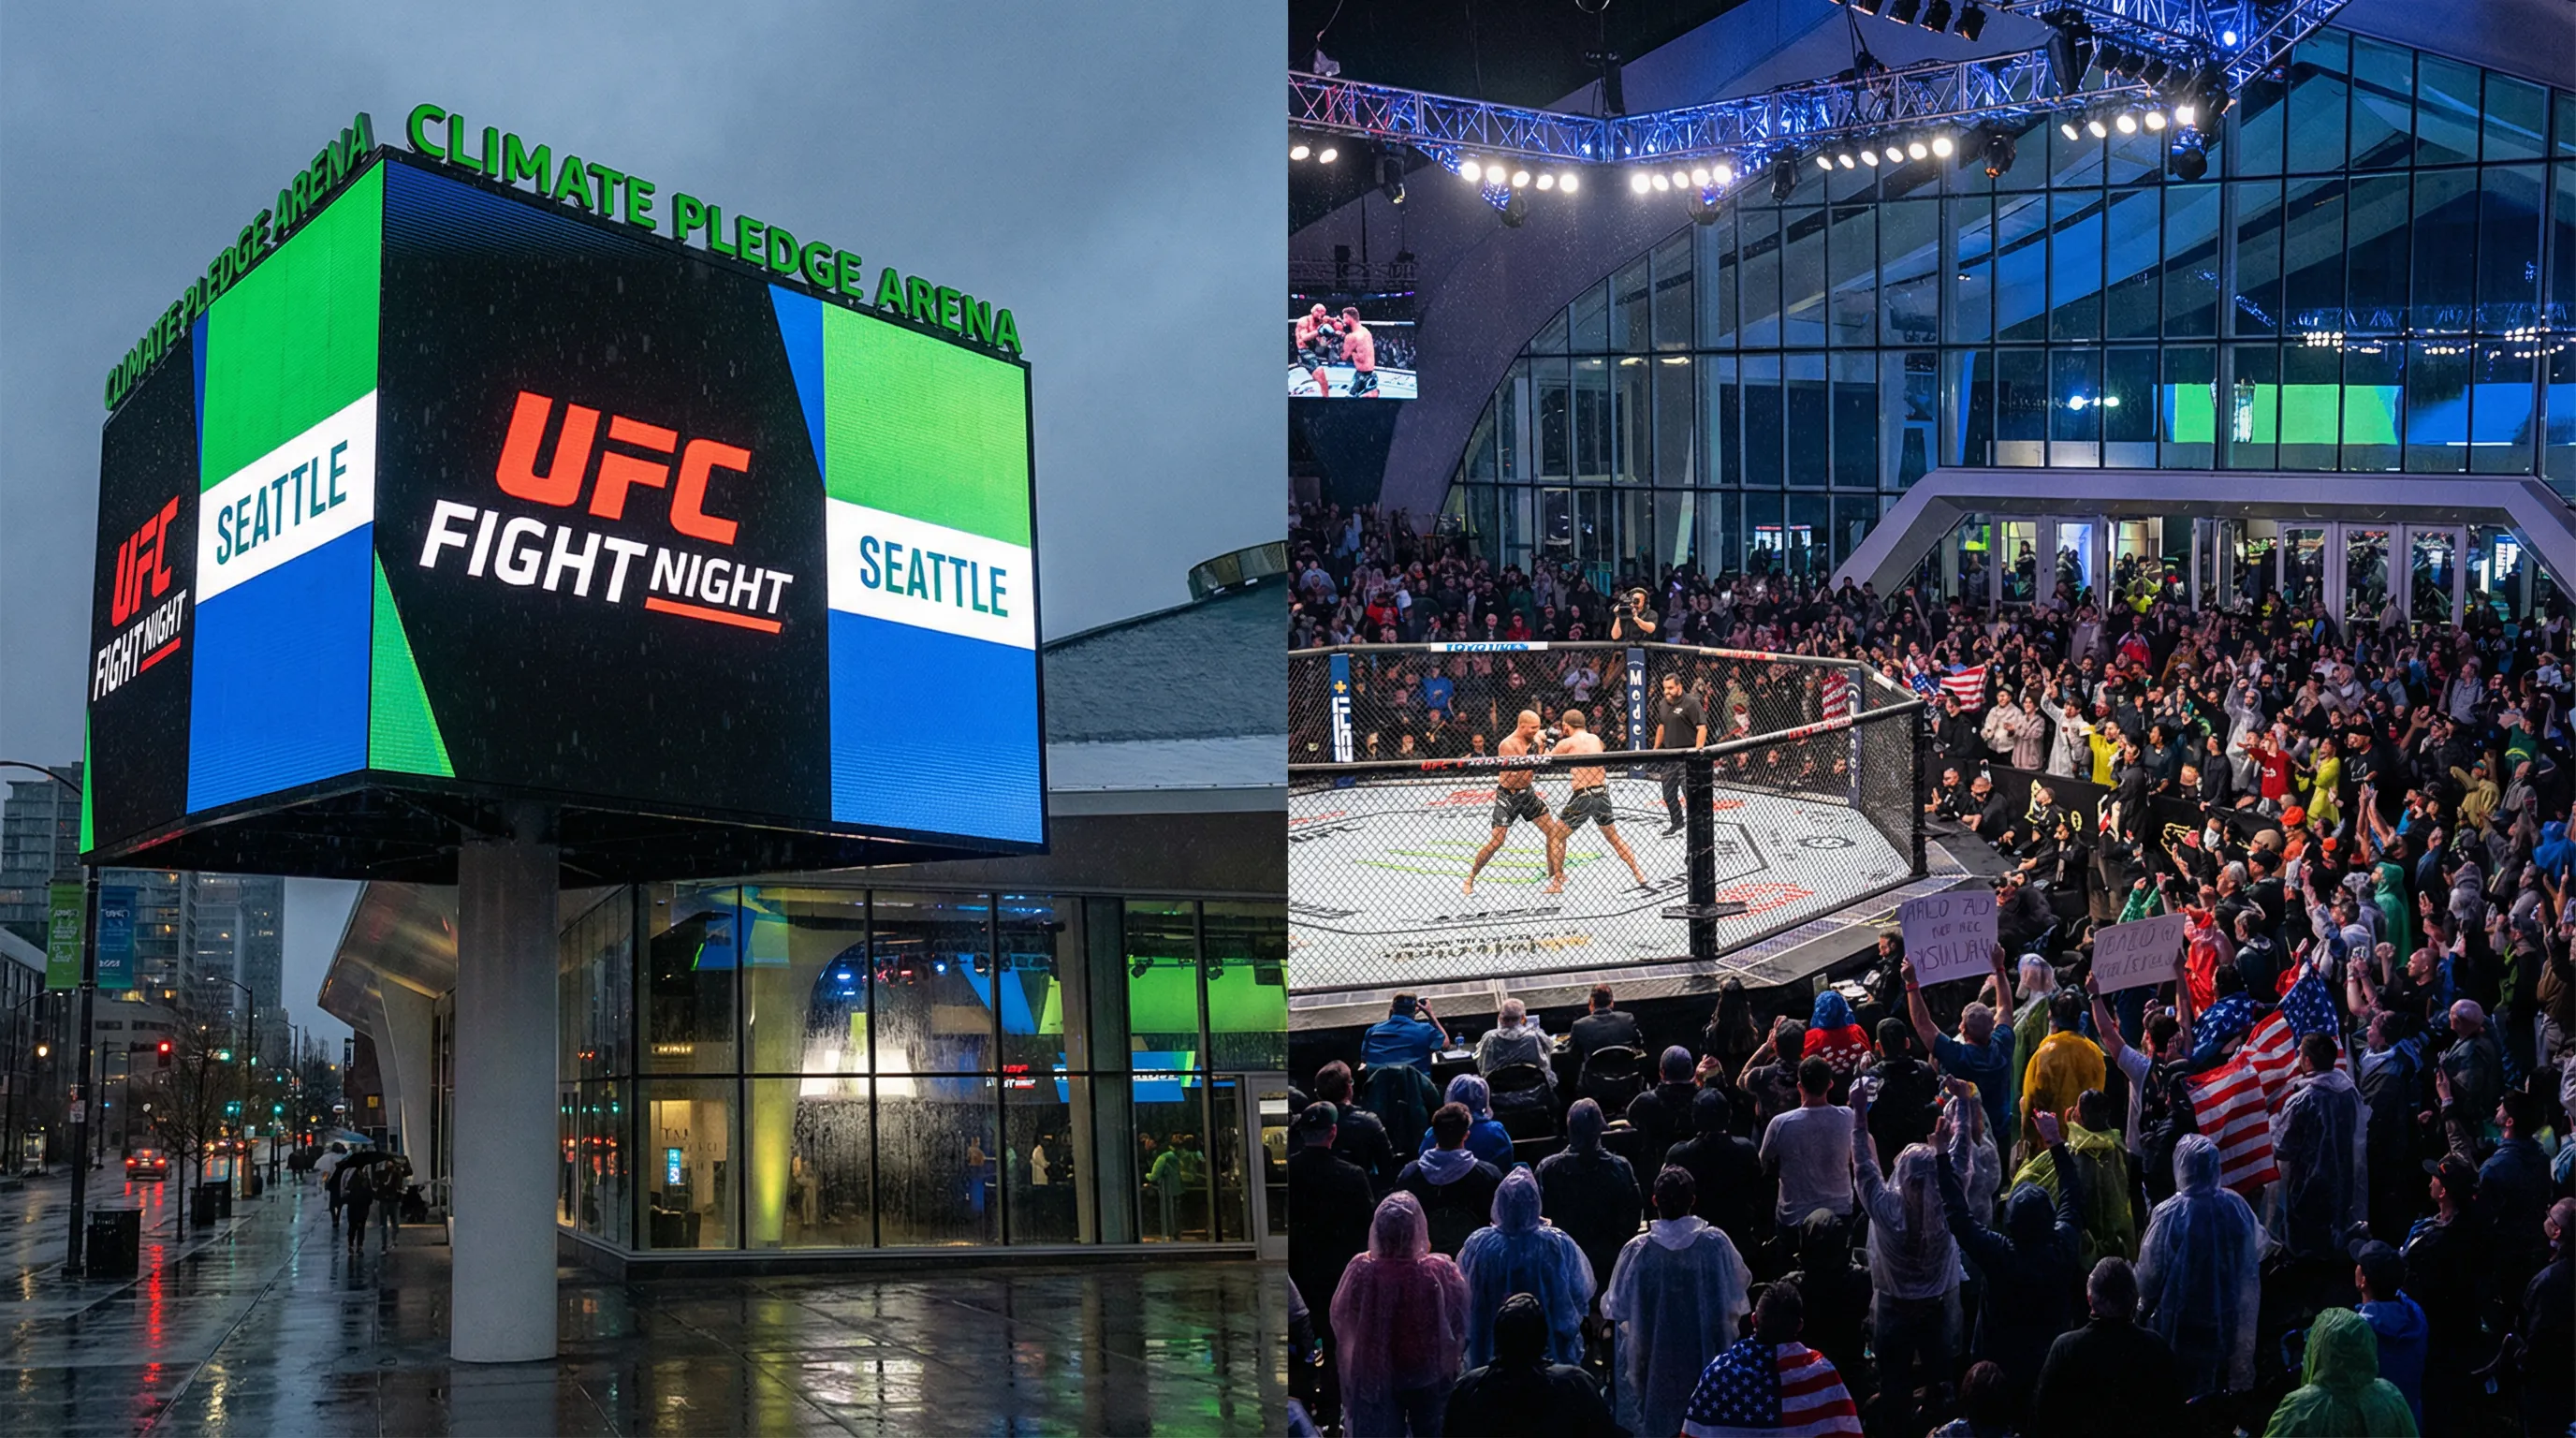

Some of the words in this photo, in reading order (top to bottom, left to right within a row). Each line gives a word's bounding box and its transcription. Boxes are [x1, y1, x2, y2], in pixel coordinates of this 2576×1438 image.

[104, 300, 183, 411] CLIMATE
[182, 208, 272, 328] PLEDGE
[271, 111, 374, 242] ARENA
[406, 103, 656, 230] CLIMATE
[671, 192, 863, 301] PLEDGE
[874, 267, 1022, 356] ARENA
[216, 439, 347, 565] SEATTLE
[495, 390, 751, 546] UFC
[111, 494, 180, 627] UFC
[419, 499, 649, 603] FIGHT
[649, 548, 794, 614] NIGHT
[860, 535, 1008, 618] SEATTLE
[93, 619, 145, 702] FIGHT
[143, 588, 187, 655] NIGHT
